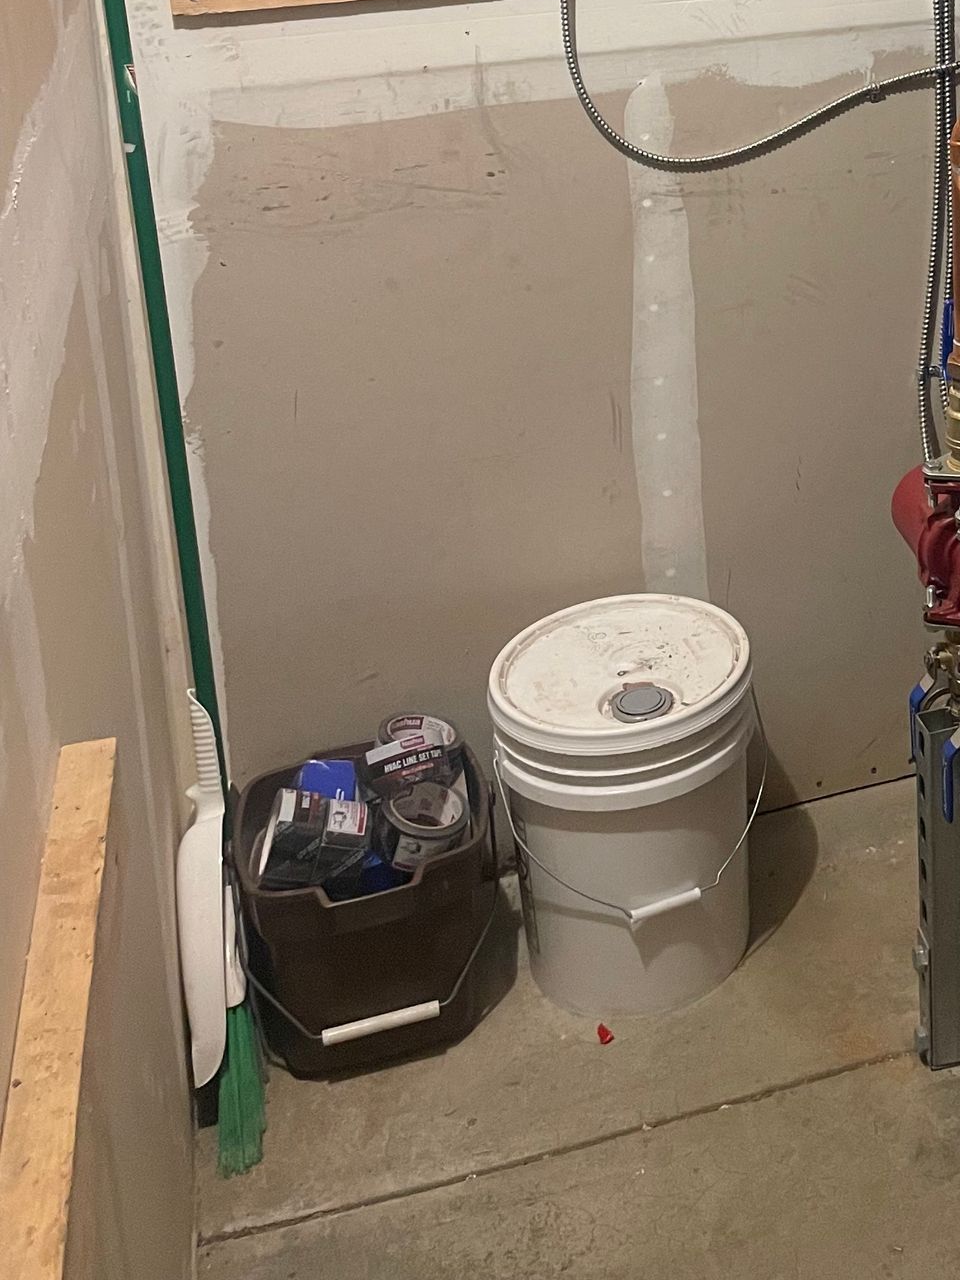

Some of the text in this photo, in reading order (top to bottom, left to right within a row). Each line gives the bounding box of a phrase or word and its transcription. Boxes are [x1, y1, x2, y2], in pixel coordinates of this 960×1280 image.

[384, 760, 402, 773] HVAC
[402, 754, 419, 768] LINE
[419, 752, 430, 761] SET
